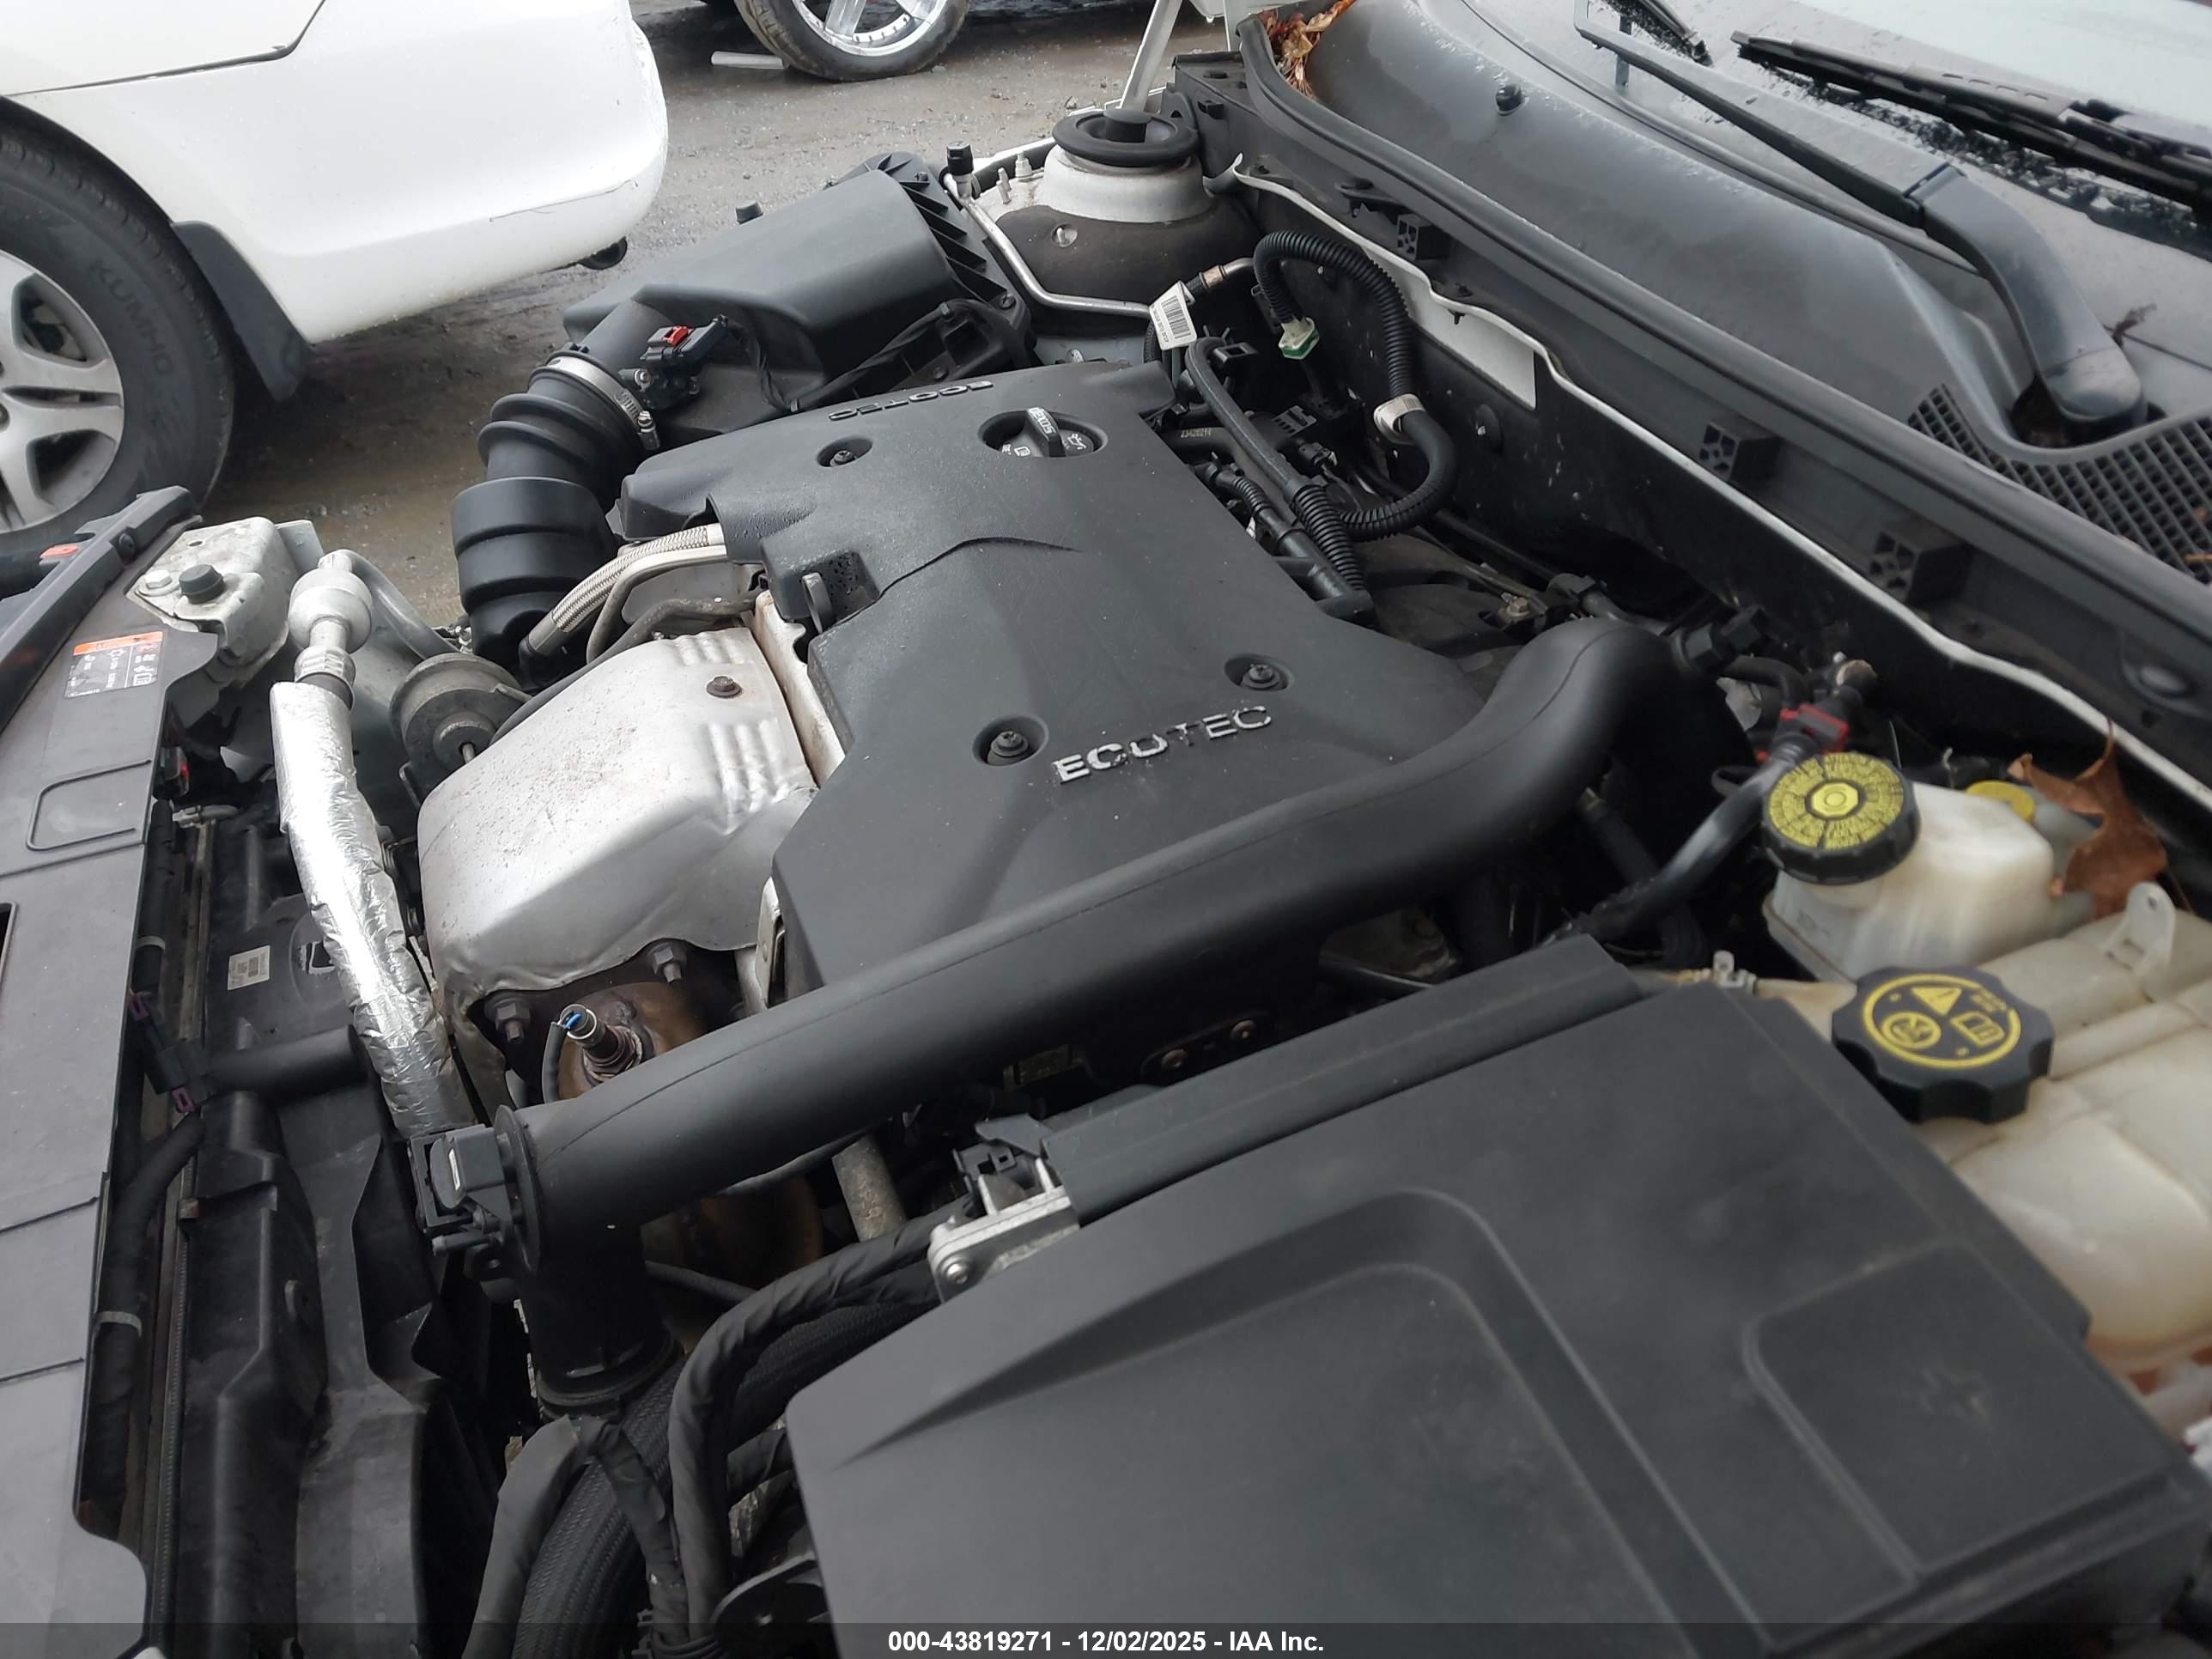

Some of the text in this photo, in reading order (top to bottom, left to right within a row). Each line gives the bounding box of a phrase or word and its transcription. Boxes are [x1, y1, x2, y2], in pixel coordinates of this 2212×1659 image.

[88, 259, 172, 374] KUMHO
[1030, 407, 1057, 434] dexos
[1051, 705, 1272, 784] ECOTEC
